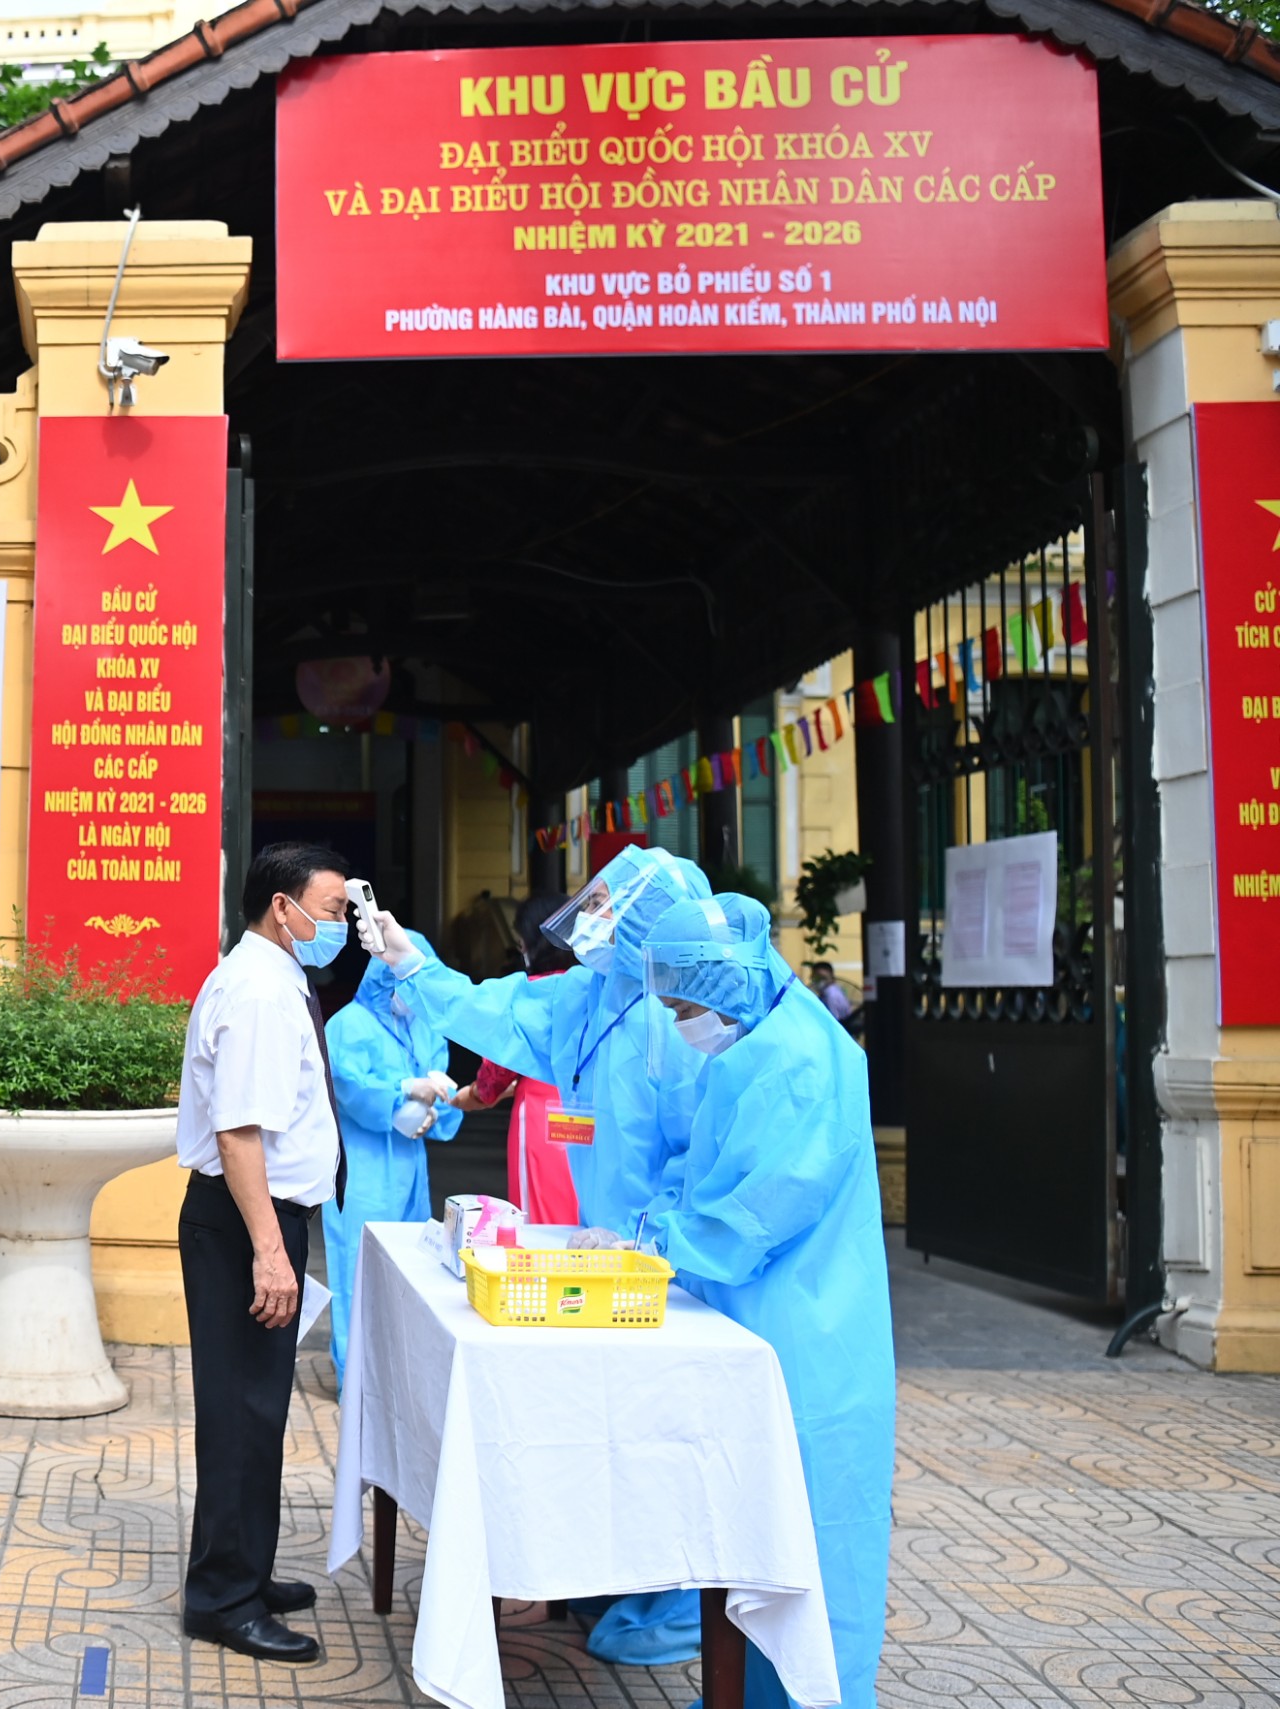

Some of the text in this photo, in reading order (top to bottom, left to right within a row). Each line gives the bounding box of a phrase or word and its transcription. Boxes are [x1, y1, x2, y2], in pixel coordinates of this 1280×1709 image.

[460, 49, 908, 120] KHU VỰC BẦU CỬ
[440, 121, 933, 174] ĐẠI BIỂU QUỐC HỘI KHÓA XV
[324, 161, 1055, 220] VÀ ĐẠI BIỂU HỘI ĐỒNG NHÂN DÂN CÁC CẤP
[514, 220, 616, 254] NHIỆM
[627, 219, 665, 247] KỲ
[676, 222, 748, 247] 2021
[784, 221, 862, 245] 2026
[546, 262, 831, 299] KHU VỰC BỎ PHIẾU SỐ 1
[385, 293, 996, 332] PHƯỜNG HÀNG BÀI, QUẬN HOÀN KIẾM, THÀNH PHỐ HÀ NỘI
[102, 583, 158, 612] BẦU CỬ
[1255, 582, 1276, 613] CỬ
[62, 616, 197, 650] ĐẠI BIỂU QUỐC HỘI
[1235, 621, 1270, 648] TÍCH
[96, 653, 160, 678] KHÓA XV
[85, 683, 171, 716] VÀ ĐẠI BIỂU
[1242, 696, 1268, 724] ĐẠI
[52, 717, 202, 749] HỘI ĐỒNG NHÂN DÂN
[94, 751, 158, 779] CÁC CẤP
[45, 787, 93, 816] NHIỆM
[97, 787, 116, 812] KỲ
[120, 792, 154, 813] 2021
[170, 793, 206, 814] 2026
[1239, 798, 1265, 830] HỘI
[79, 821, 170, 852] LÀ NGÀY HỘI
[67, 850, 180, 882] CỦA TOÀN DÂN!
[1234, 870, 1280, 902] NHIỆM
